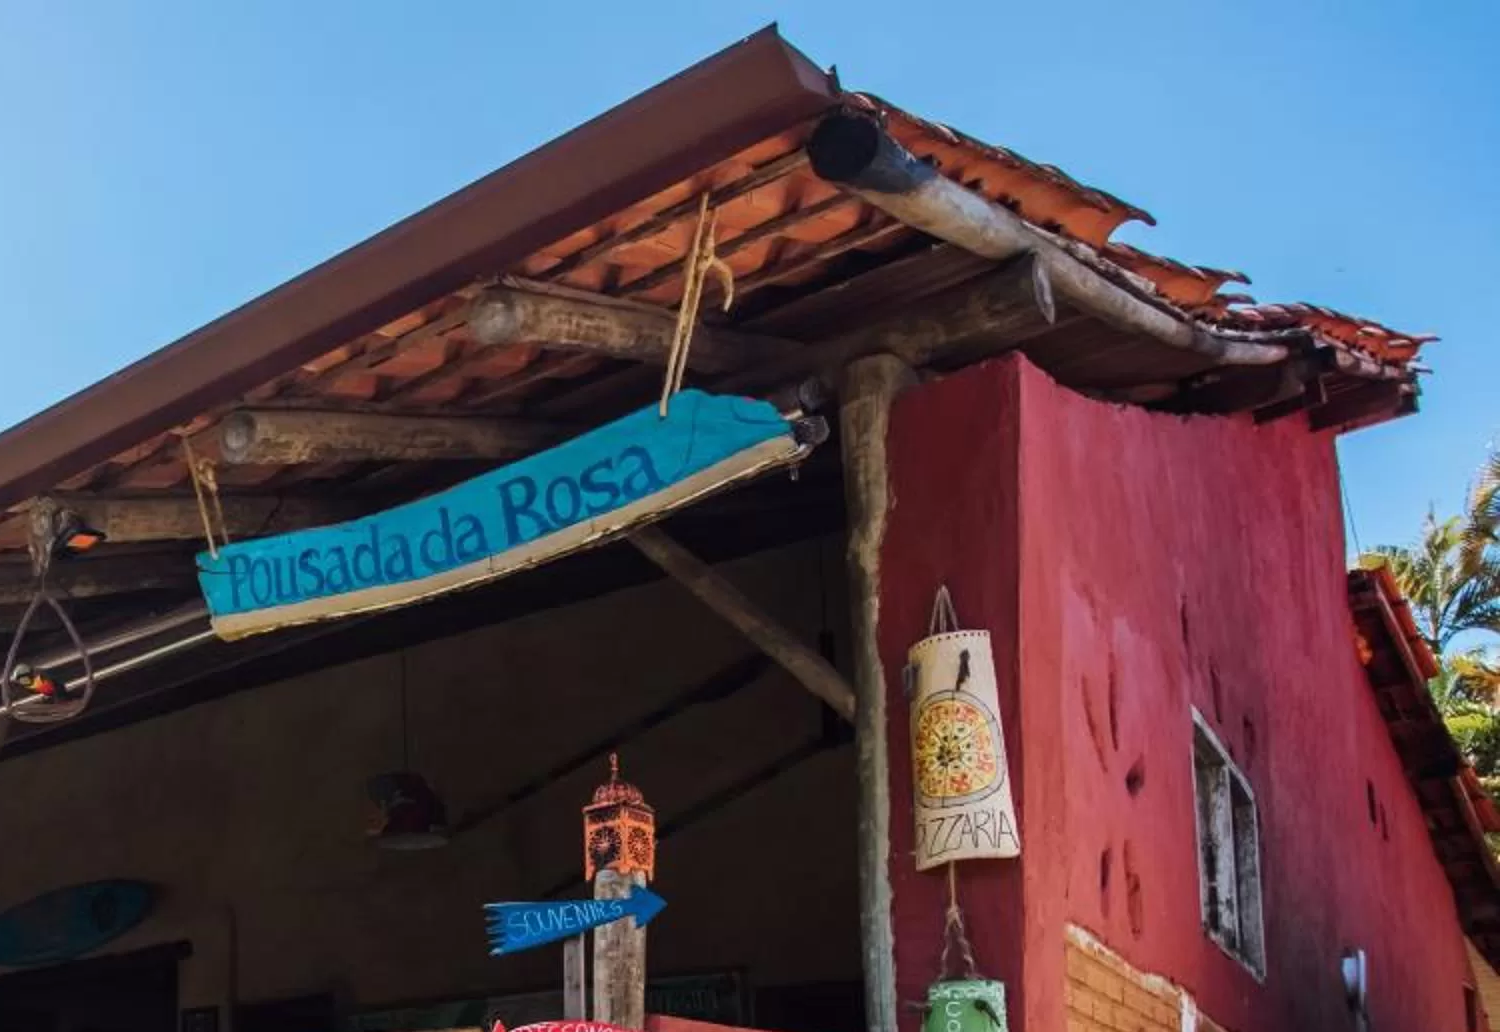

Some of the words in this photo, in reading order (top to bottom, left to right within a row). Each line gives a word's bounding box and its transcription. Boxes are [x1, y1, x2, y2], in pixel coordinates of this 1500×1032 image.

[227, 523, 412, 609] Pousada
[418, 507, 489, 567] da
[496, 445, 663, 543] Rosa
[506, 900, 624, 942] SOUVENIRS
